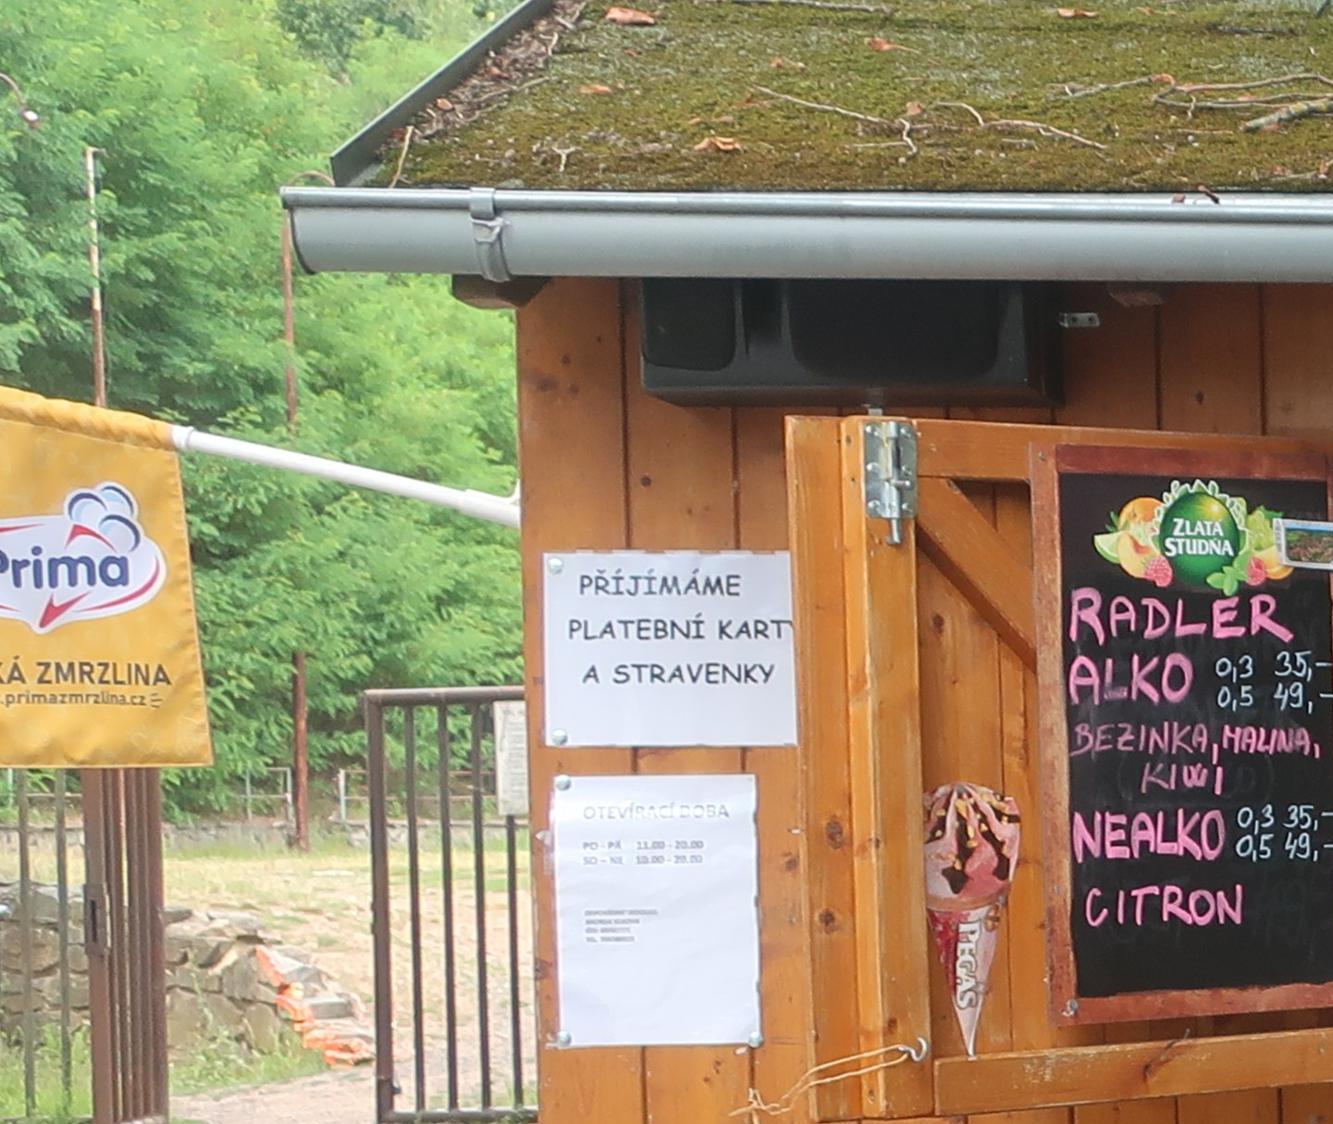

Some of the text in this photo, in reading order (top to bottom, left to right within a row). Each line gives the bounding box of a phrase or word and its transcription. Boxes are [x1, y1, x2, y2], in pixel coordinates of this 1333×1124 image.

[568, 612, 705, 640] PLATEBNÍ
[1070, 586, 1294, 646] RADLER
[36, 662, 172, 686] ZMRZLINA
[582, 663, 775, 684] A STRAVENKY
[1069, 651, 1332, 706] ALKO 0,3 35,-
[1217, 686, 1253, 711] 0,5
[1072, 808, 1226, 864] NEALKO
[1236, 804, 1274, 835] 0,3
[1235, 834, 1274, 861] 0,5
[1085, 883, 1242, 925] CITRON
